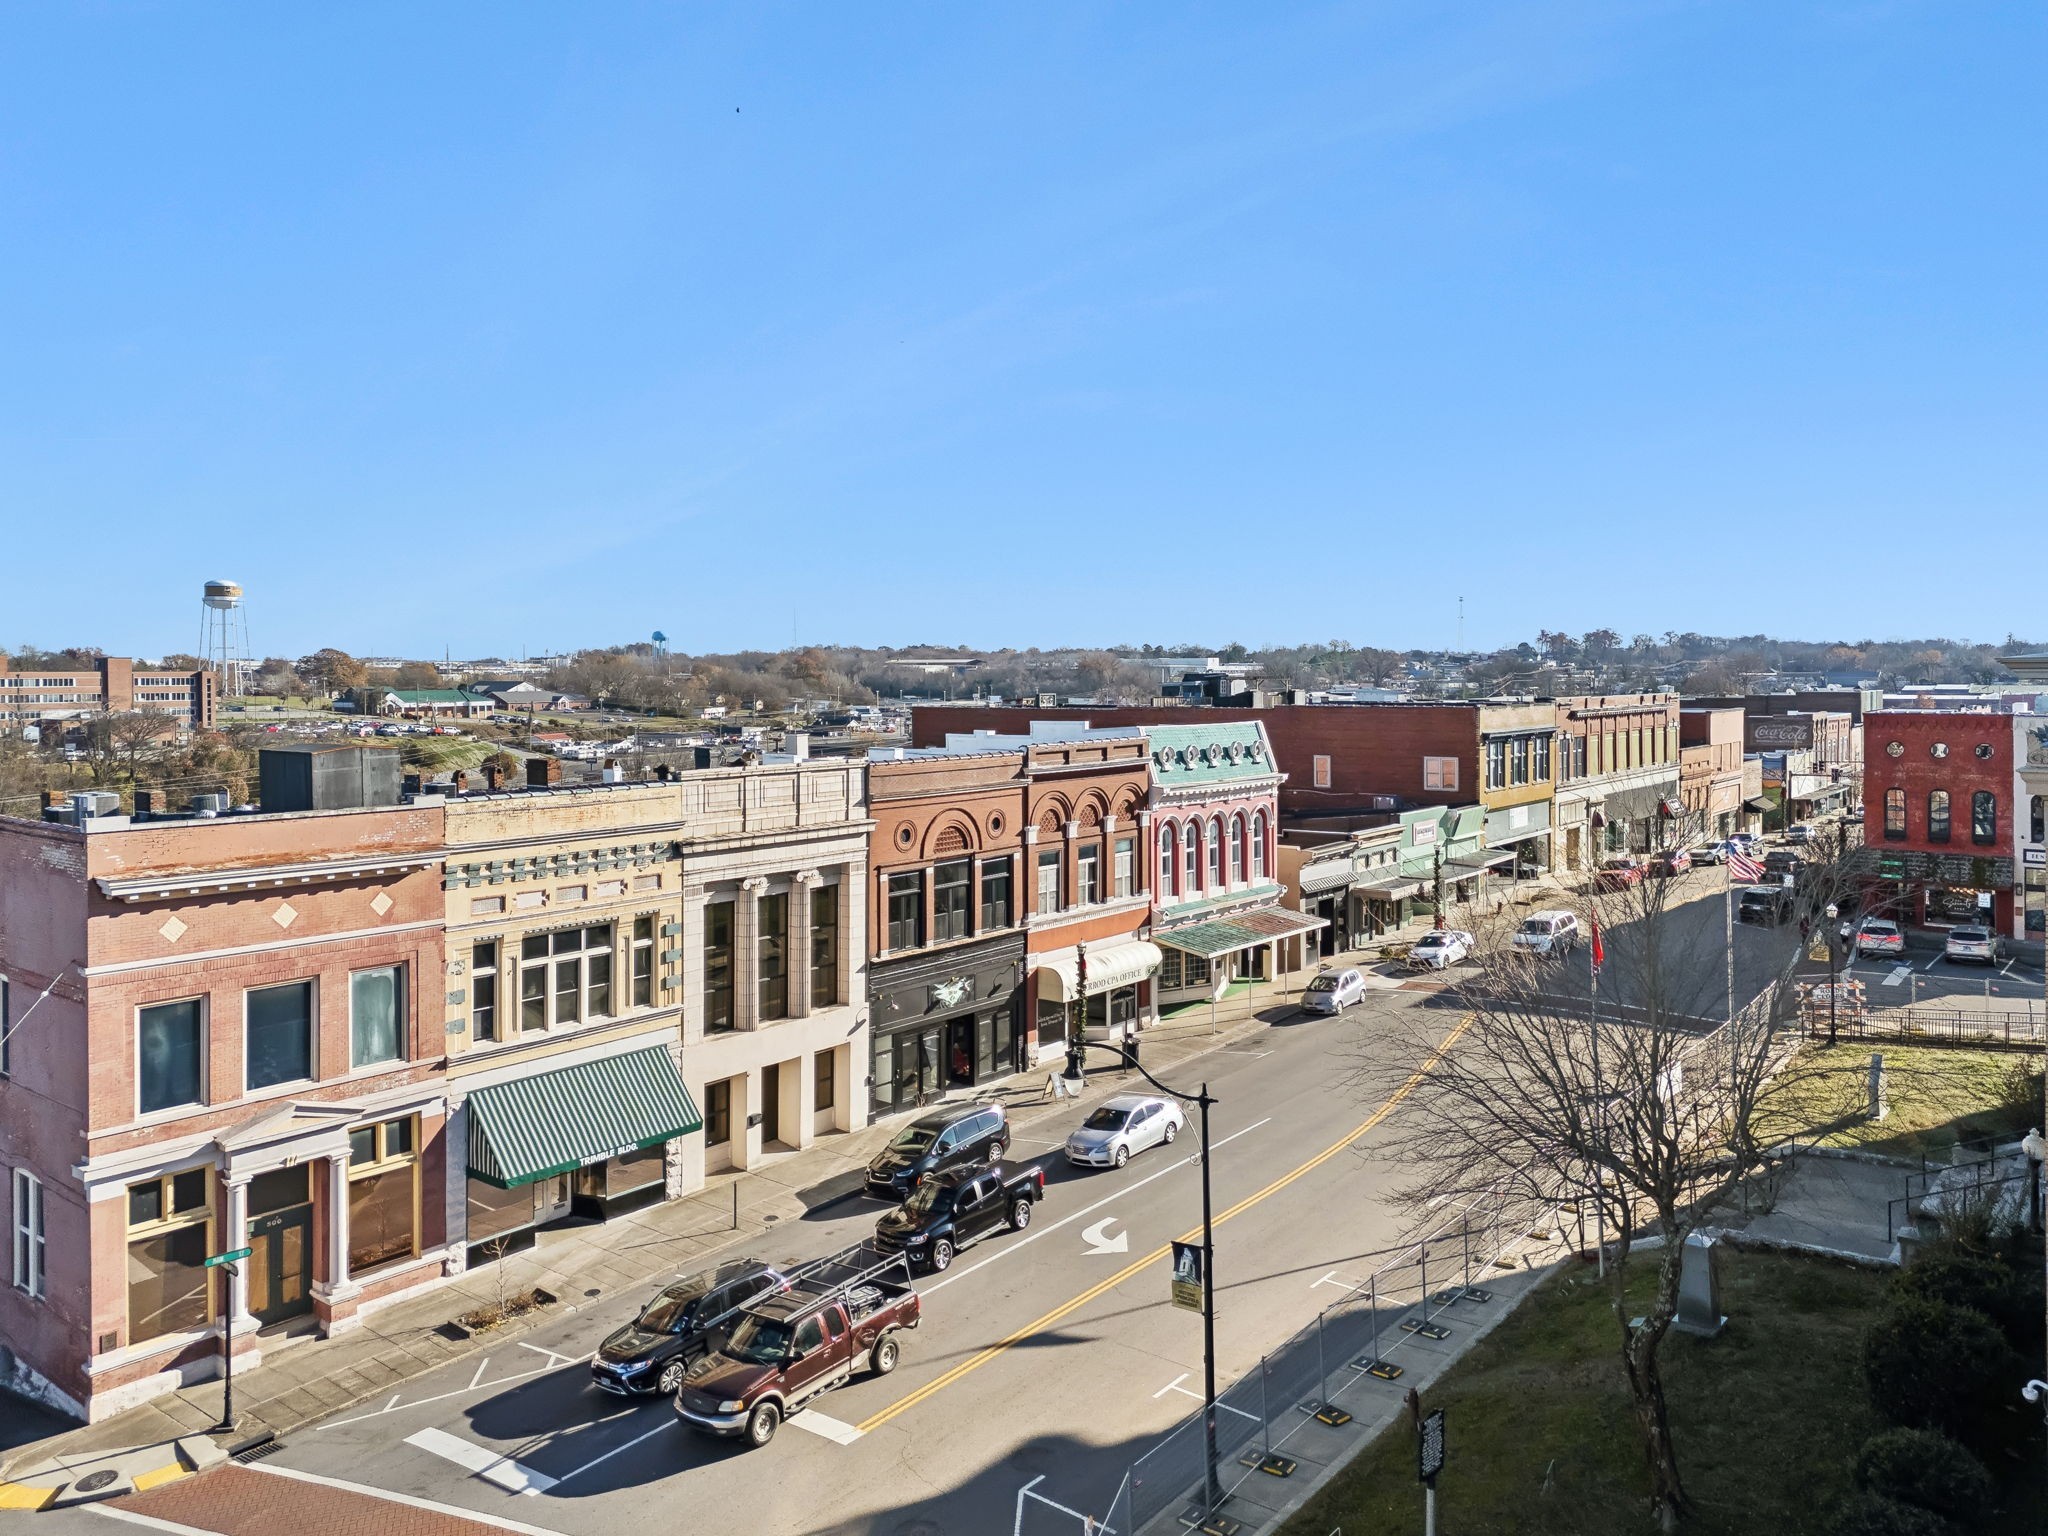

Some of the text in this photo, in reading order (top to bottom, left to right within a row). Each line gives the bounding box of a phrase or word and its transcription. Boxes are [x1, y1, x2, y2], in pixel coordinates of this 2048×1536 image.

[1755, 725, 1808, 740] Coca-Cola
[1107, 976, 1120, 986] CPA
[1120, 969, 1142, 981] OFFICE
[580, 1143, 639, 1166] TRIMBLE BLDG.
